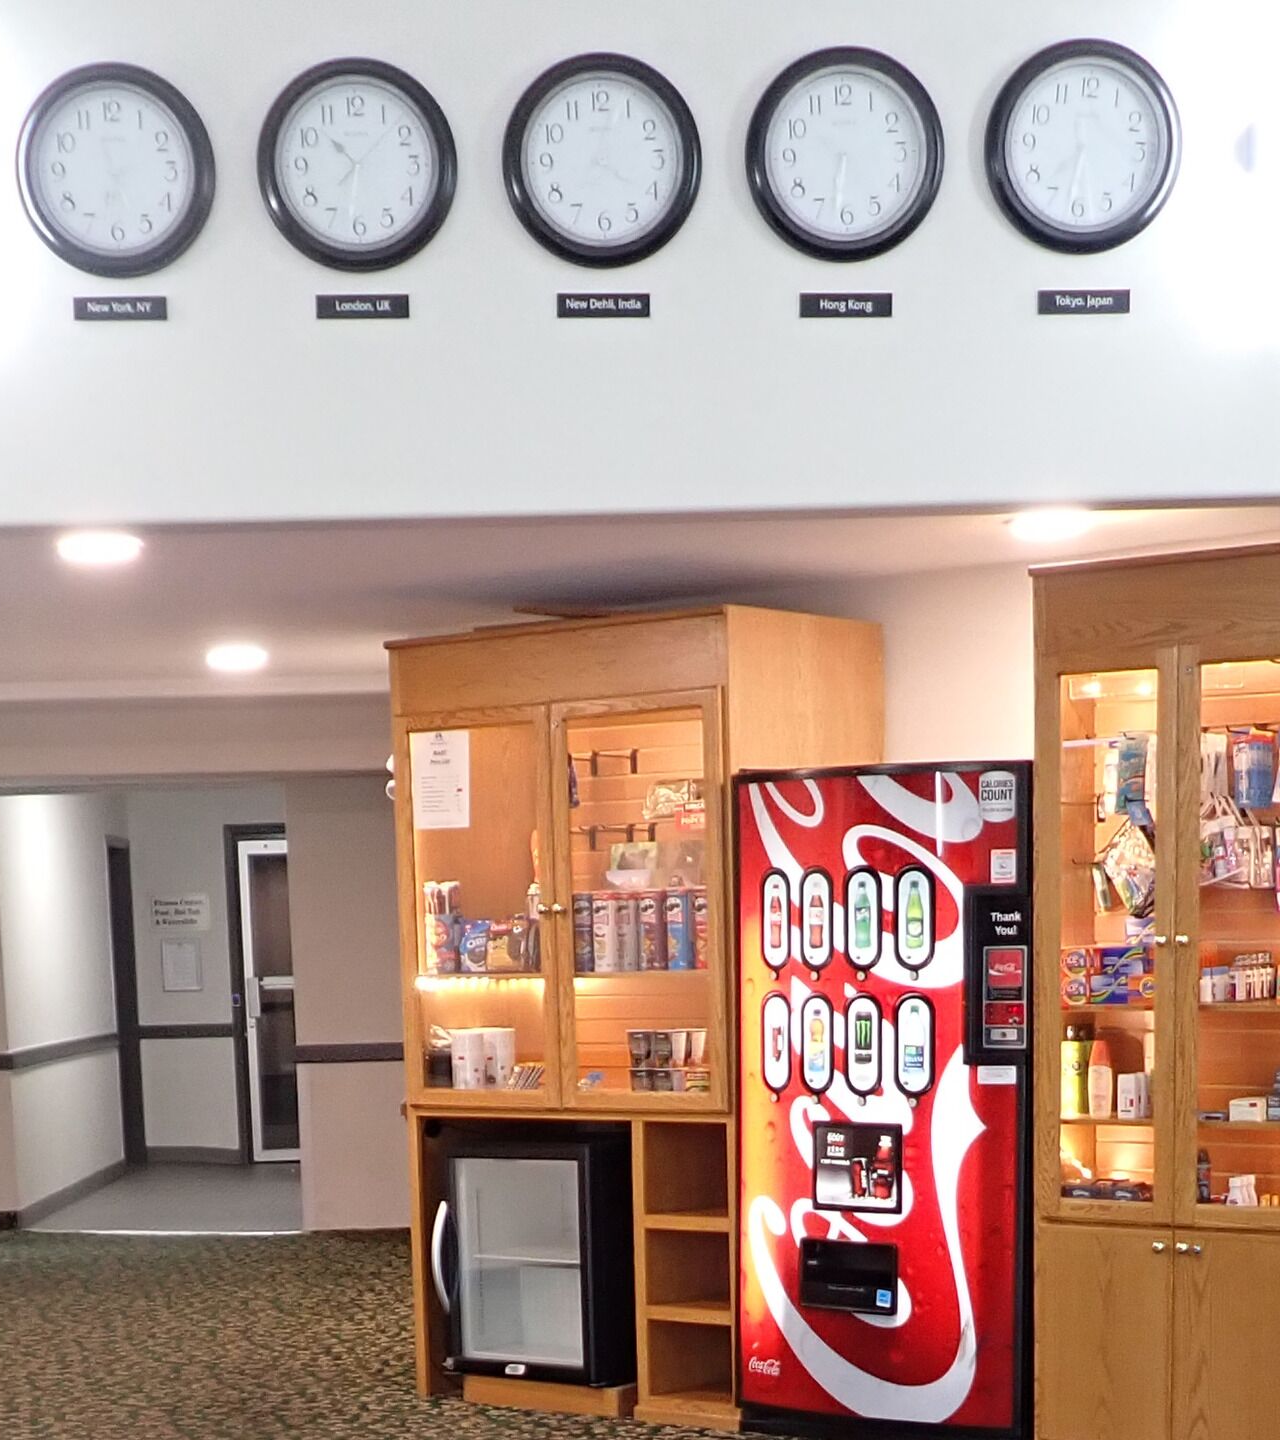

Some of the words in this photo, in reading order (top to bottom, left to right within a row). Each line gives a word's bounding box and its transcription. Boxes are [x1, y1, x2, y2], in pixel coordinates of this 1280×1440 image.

[834, 84, 852, 106] 12
[1055, 83, 1068, 104] 11
[1082, 76, 1100, 99] 12
[1114, 87, 1119, 108] 1
[102, 101, 120, 122] 12
[346, 96, 365, 117] 12
[566, 100, 579, 121] 11
[592, 90, 610, 112] 12
[626, 99, 631, 119] 1
[809, 94, 822, 115] 11
[868, 91, 873, 112] 1
[77, 110, 90, 131] 11
[137, 110, 143, 131] 1
[321, 104, 333, 126] 11
[381, 104, 386, 125] 1
[884, 111, 899, 133] 2
[1032, 103, 1050, 125] 10
[1127, 111, 1142, 133] 2
[300, 126, 318, 149] 10
[397, 125, 411, 147] 2
[546, 123, 564, 144] 10
[642, 119, 657, 141] 2
[788, 118, 807, 140] 10
[56, 131, 76, 154] 10
[154, 130, 169, 152] 2
[894, 140, 907, 163] 3
[1022, 132, 1037, 154] 9
[1134, 141, 1146, 163] 3
[294, 156, 309, 177] 9
[406, 154, 421, 176] 3
[539, 151, 554, 174] 9
[651, 148, 665, 171] 3
[782, 148, 797, 168] 9
[51, 161, 66, 179] 9
[161, 160, 178, 182] 3
[1024, 163, 1041, 184] 8
[547, 183, 563, 204] 8
[644, 181, 658, 201] 4
[790, 176, 806, 199] 8
[887, 173, 900, 193] 4
[1121, 172, 1136, 193] 4
[61, 191, 76, 213] 8
[157, 192, 172, 213] 4
[302, 184, 318, 207] 8
[400, 186, 413, 207] 4
[867, 195, 881, 217] 5
[1046, 185, 1059, 207] 7
[1101, 191, 1113, 213] 5
[324, 207, 338, 229] 7
[379, 207, 394, 229] 5
[569, 202, 583, 224] 7
[624, 202, 639, 223] 5
[812, 197, 825, 220] 7
[839, 203, 854, 226] 6
[1070, 198, 1085, 218] 6
[82, 212, 96, 235] 7
[110, 220, 125, 242] 6
[139, 213, 153, 234] 5
[352, 215, 367, 237] 6
[597, 209, 612, 232] 6
[86, 302, 109, 312] New
[136, 302, 152, 312] NY
[376, 300, 391, 311] UK
[565, 298, 588, 309] New
[618, 299, 642, 309] India
[819, 299, 846, 312] Hong
[848, 299, 873, 312] Kong
[1086, 295, 1113, 308] Japan
[981, 780, 1013, 788] CALORIES
[981, 789, 1013, 801] COUNT
[990, 911, 1022, 921] Thank
[994, 925, 1018, 935] You!
